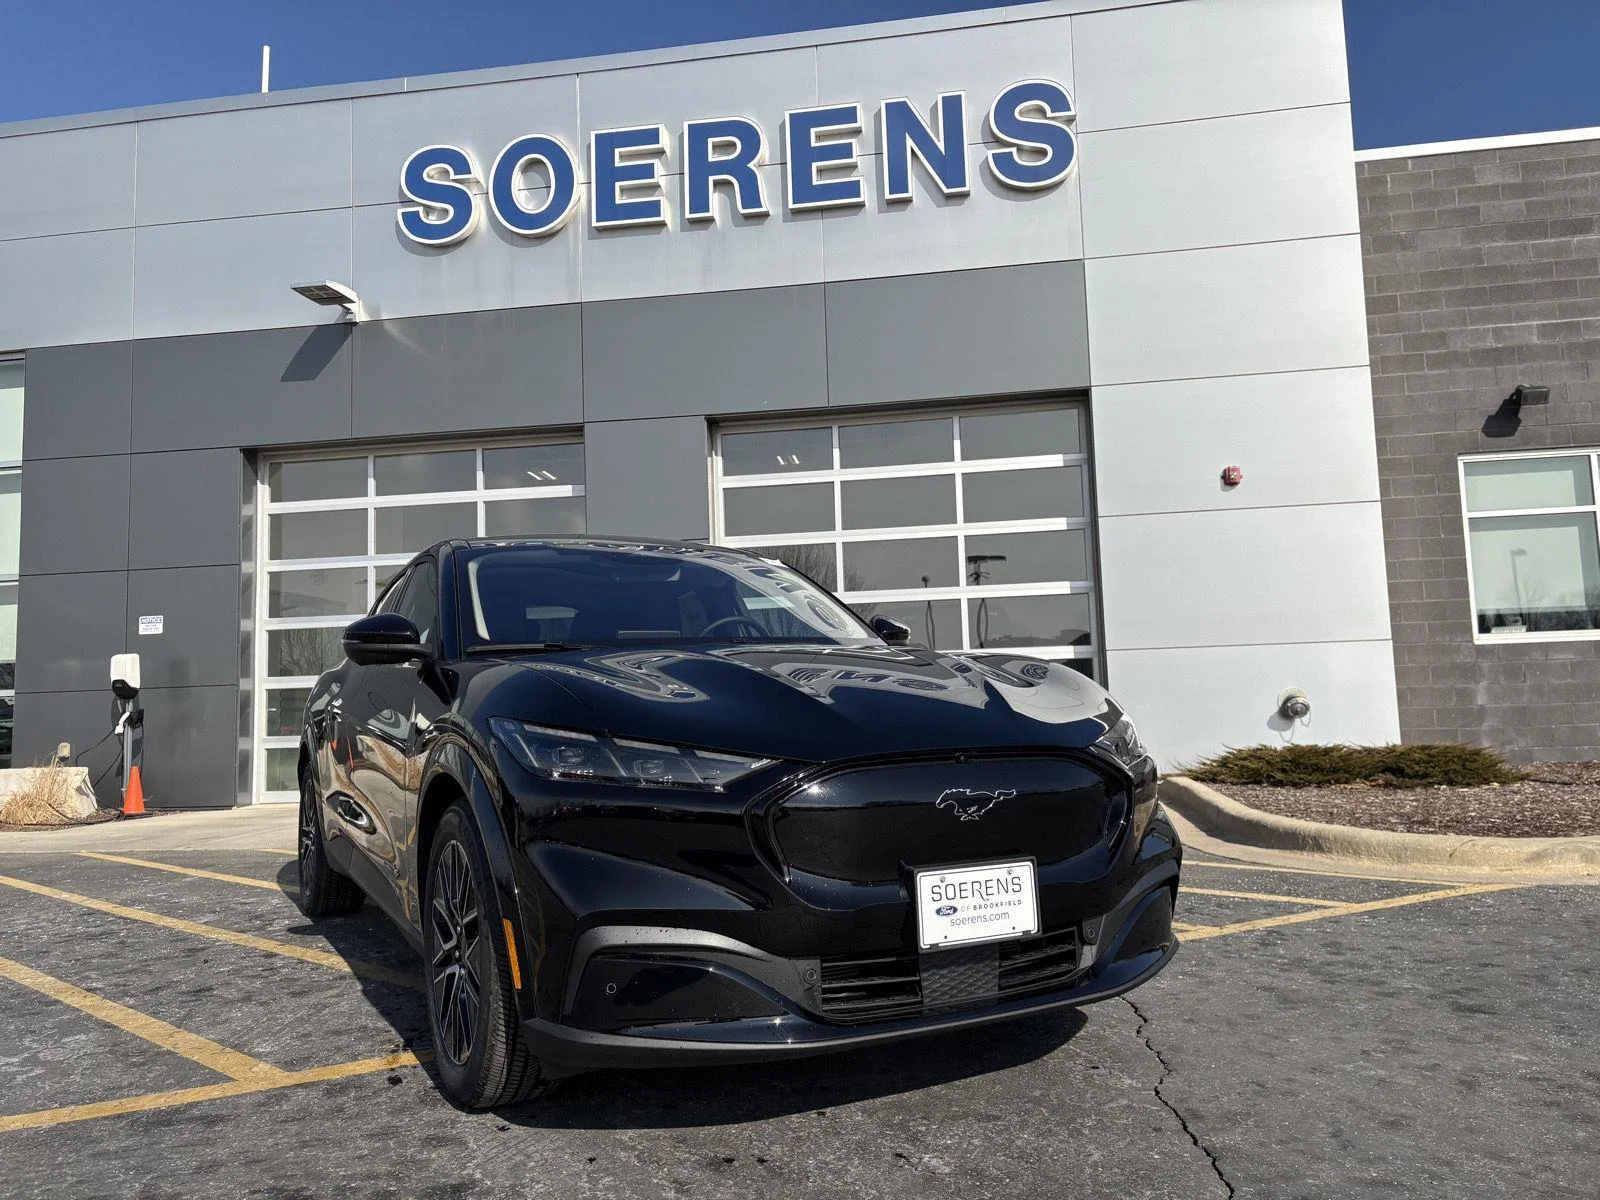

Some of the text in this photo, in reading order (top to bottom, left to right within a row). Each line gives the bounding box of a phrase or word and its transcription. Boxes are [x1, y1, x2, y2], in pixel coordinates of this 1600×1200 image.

[397, 79, 1078, 248] SOERENS
[931, 876, 1022, 901] SOERENS
[973, 900, 1022, 911] BROOKFIELD
[950, 911, 1009, 926] soerens.com
